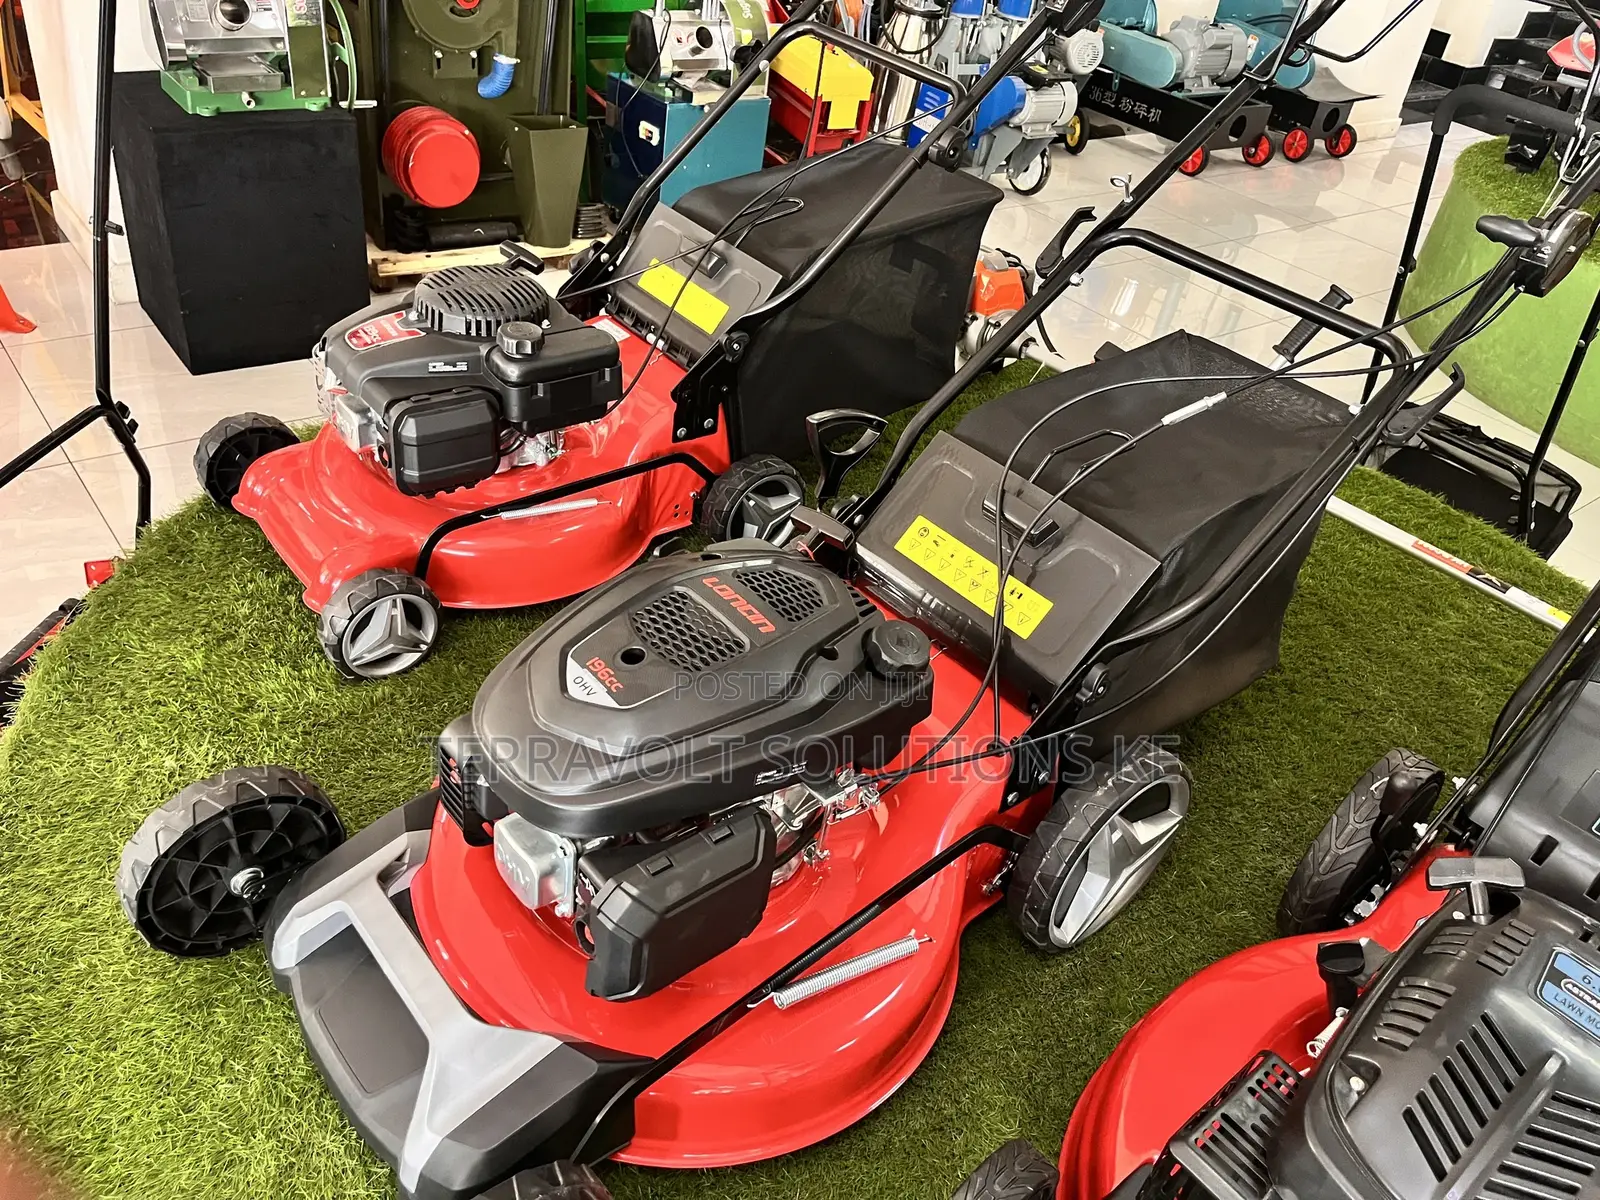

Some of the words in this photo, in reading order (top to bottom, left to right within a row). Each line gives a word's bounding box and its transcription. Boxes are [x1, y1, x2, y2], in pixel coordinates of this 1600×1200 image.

[573, 676, 597, 696] OHV
[586, 656, 624, 692] 196cc
[1553, 992, 1584, 1018] LAWN
